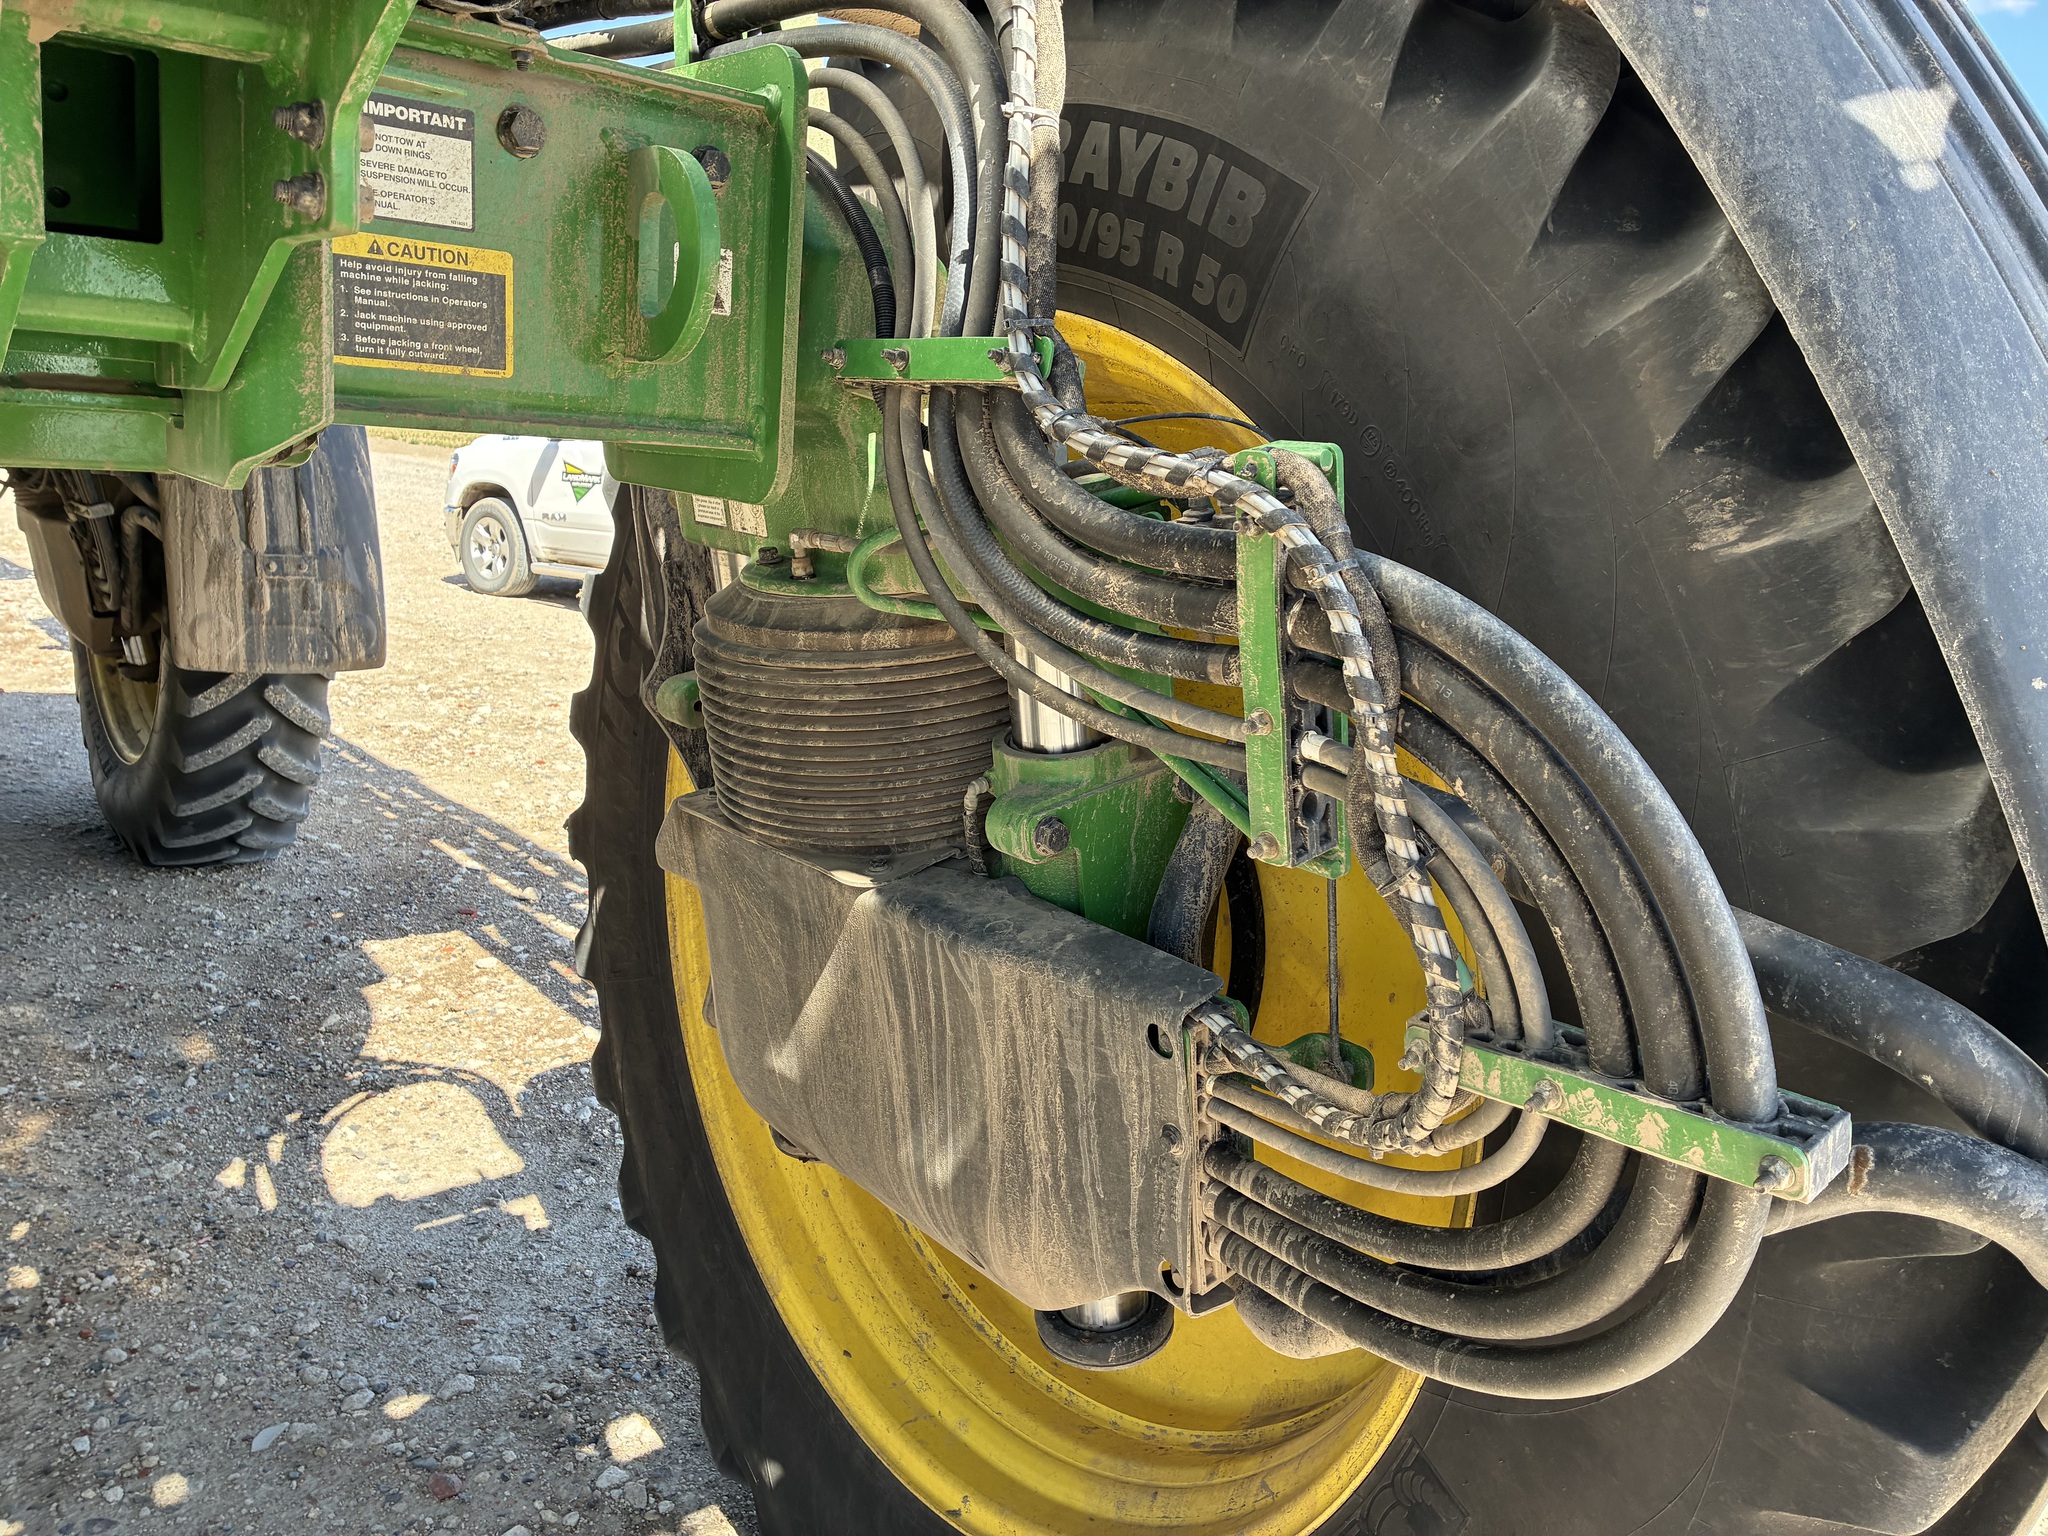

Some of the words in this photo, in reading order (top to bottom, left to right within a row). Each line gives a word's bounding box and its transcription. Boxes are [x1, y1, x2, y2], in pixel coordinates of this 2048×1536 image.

[362, 100, 466, 131] IMPORTANT
[375, 133, 392, 145] NOT
[394, 135, 413, 147] TOW
[416, 140, 427, 149] AT
[375, 144, 402, 156] DOWN
[404, 150, 433, 161] RINGS.
[360, 159, 395, 172] SEVERE
[397, 164, 435, 178] DAMAGE
[436, 171, 448, 180] TO
[360, 170, 416, 186] SUSPENSION
[416, 179, 438, 189] WILL
[439, 182, 471, 194] OCCUR.
[381, 190, 436, 206] OPERATOR'S
[387, 242, 469, 266] CAUTION
[340, 259, 363, 271] Help
[365, 262, 392, 273] avoid
[395, 266, 423, 278] injury
[425, 270, 446, 280] from
[449, 272, 478, 285] falling
[340, 270, 382, 282] machine
[384, 275, 410, 286] while
[412, 278, 450, 291] jacking:
[1153, 231, 1185, 288] R
[1192, 254, 1248, 324] 50
[340, 285, 348, 293] 1.
[354, 286, 371, 296] See
[374, 288, 429, 303] instructions
[431, 295, 440, 304] in
[442, 296, 488, 310] Operator's
[354, 297, 391, 308] Manual.
[340, 309, 349, 317] 2.
[354, 310, 377, 321] Jack
[379, 314, 418, 325] machine
[420, 317, 445, 329] using
[447, 320, 488, 332] approved
[355, 321, 407, 334] equipment.
[340, 334, 350, 342] 3.
[355, 335, 386, 346] Before
[388, 337, 421, 349] jacking
[423, 341, 429, 349] a
[431, 341, 453, 351] front
[454, 344, 483, 355] wheel,
[355, 345, 375, 355] turn
[377, 346, 384, 355] it
[386, 347, 406, 358] fully
[409, 350, 448, 361] outward.
[542, 513, 567, 522] RAM
